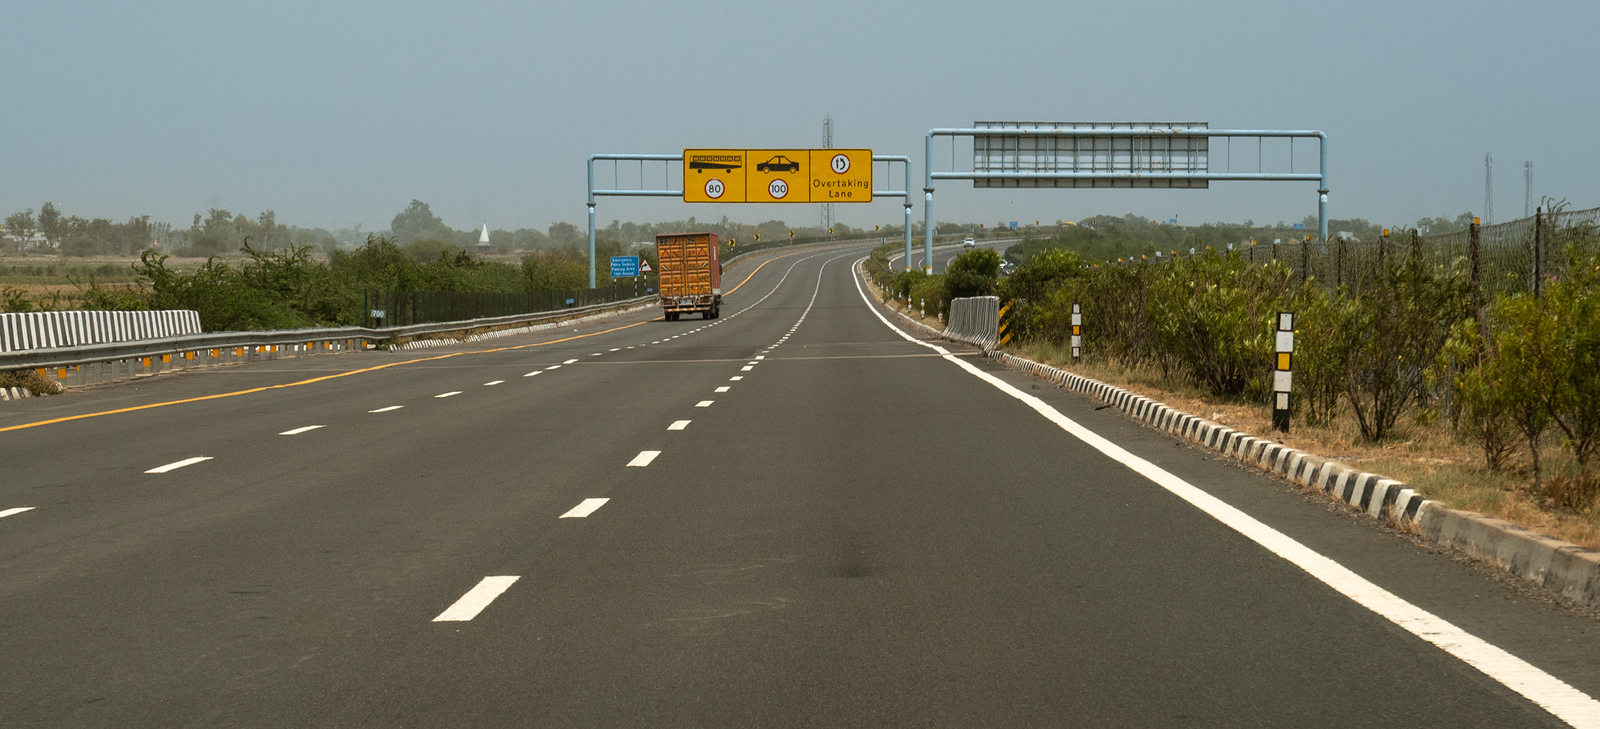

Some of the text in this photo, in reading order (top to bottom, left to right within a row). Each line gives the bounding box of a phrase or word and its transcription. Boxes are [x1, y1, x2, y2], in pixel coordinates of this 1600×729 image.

[813, 179, 869, 189] Overtaking
[708, 185, 721, 193] 80
[771, 185, 786, 193] 100
[829, 190, 853, 198] Lane
